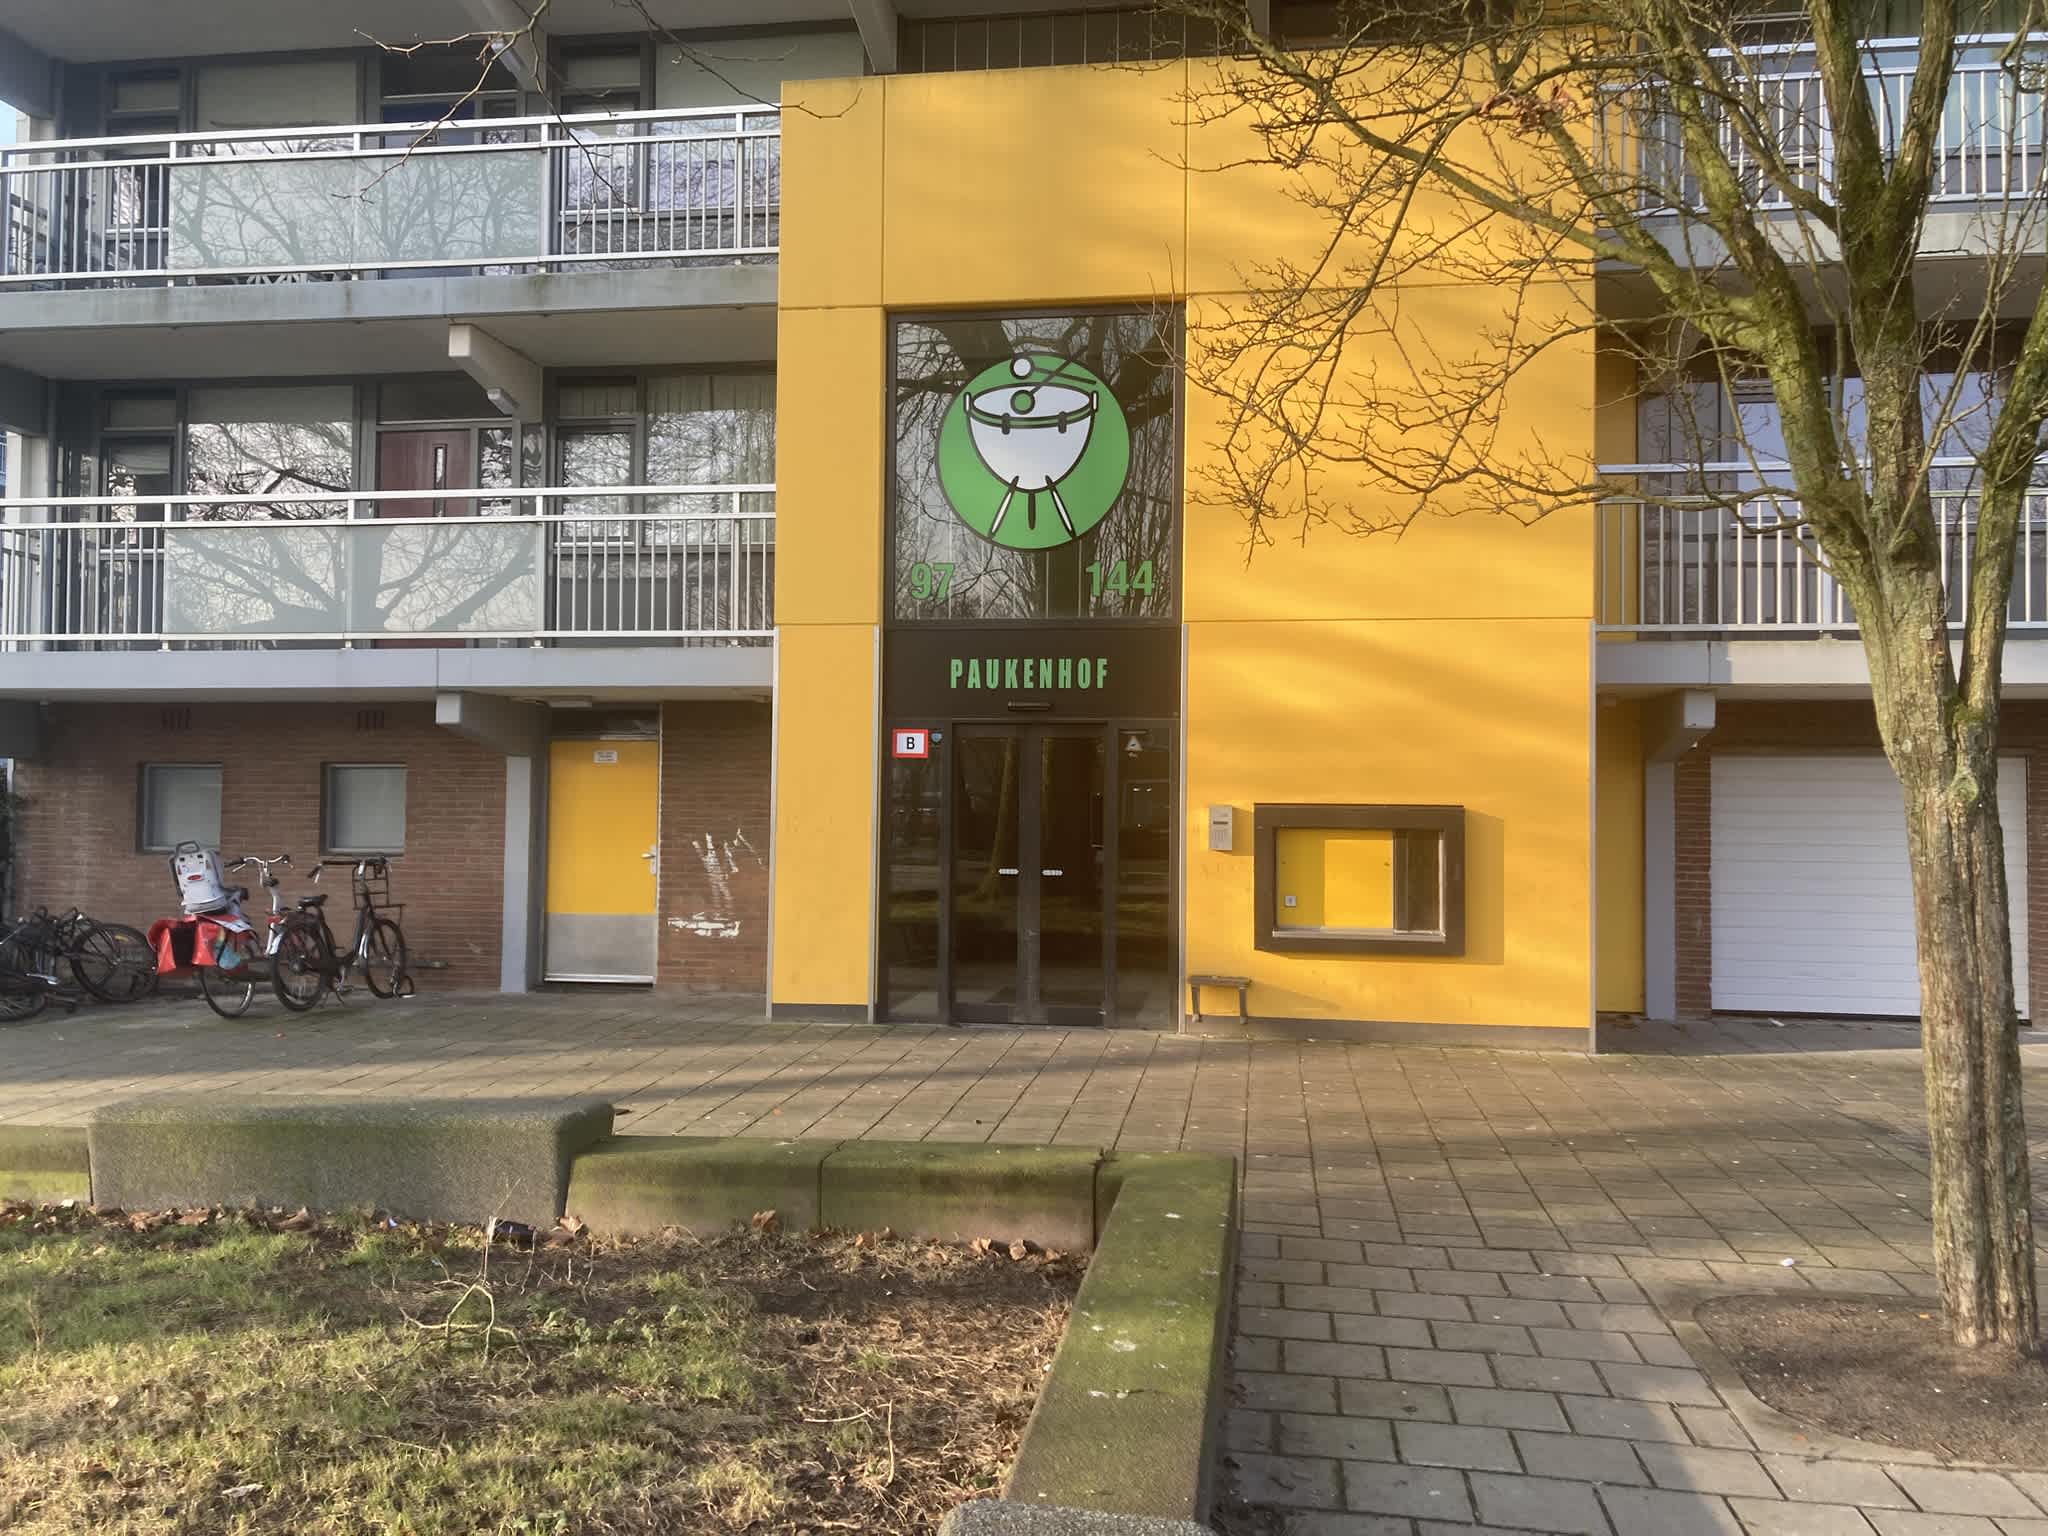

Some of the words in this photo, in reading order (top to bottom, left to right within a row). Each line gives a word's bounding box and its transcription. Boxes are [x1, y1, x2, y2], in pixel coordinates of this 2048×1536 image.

[911, 562, 955, 600] 97
[1086, 561, 1155, 597] 144
[950, 658, 1108, 690] PAUKENHOF
[906, 736, 915, 750] B
